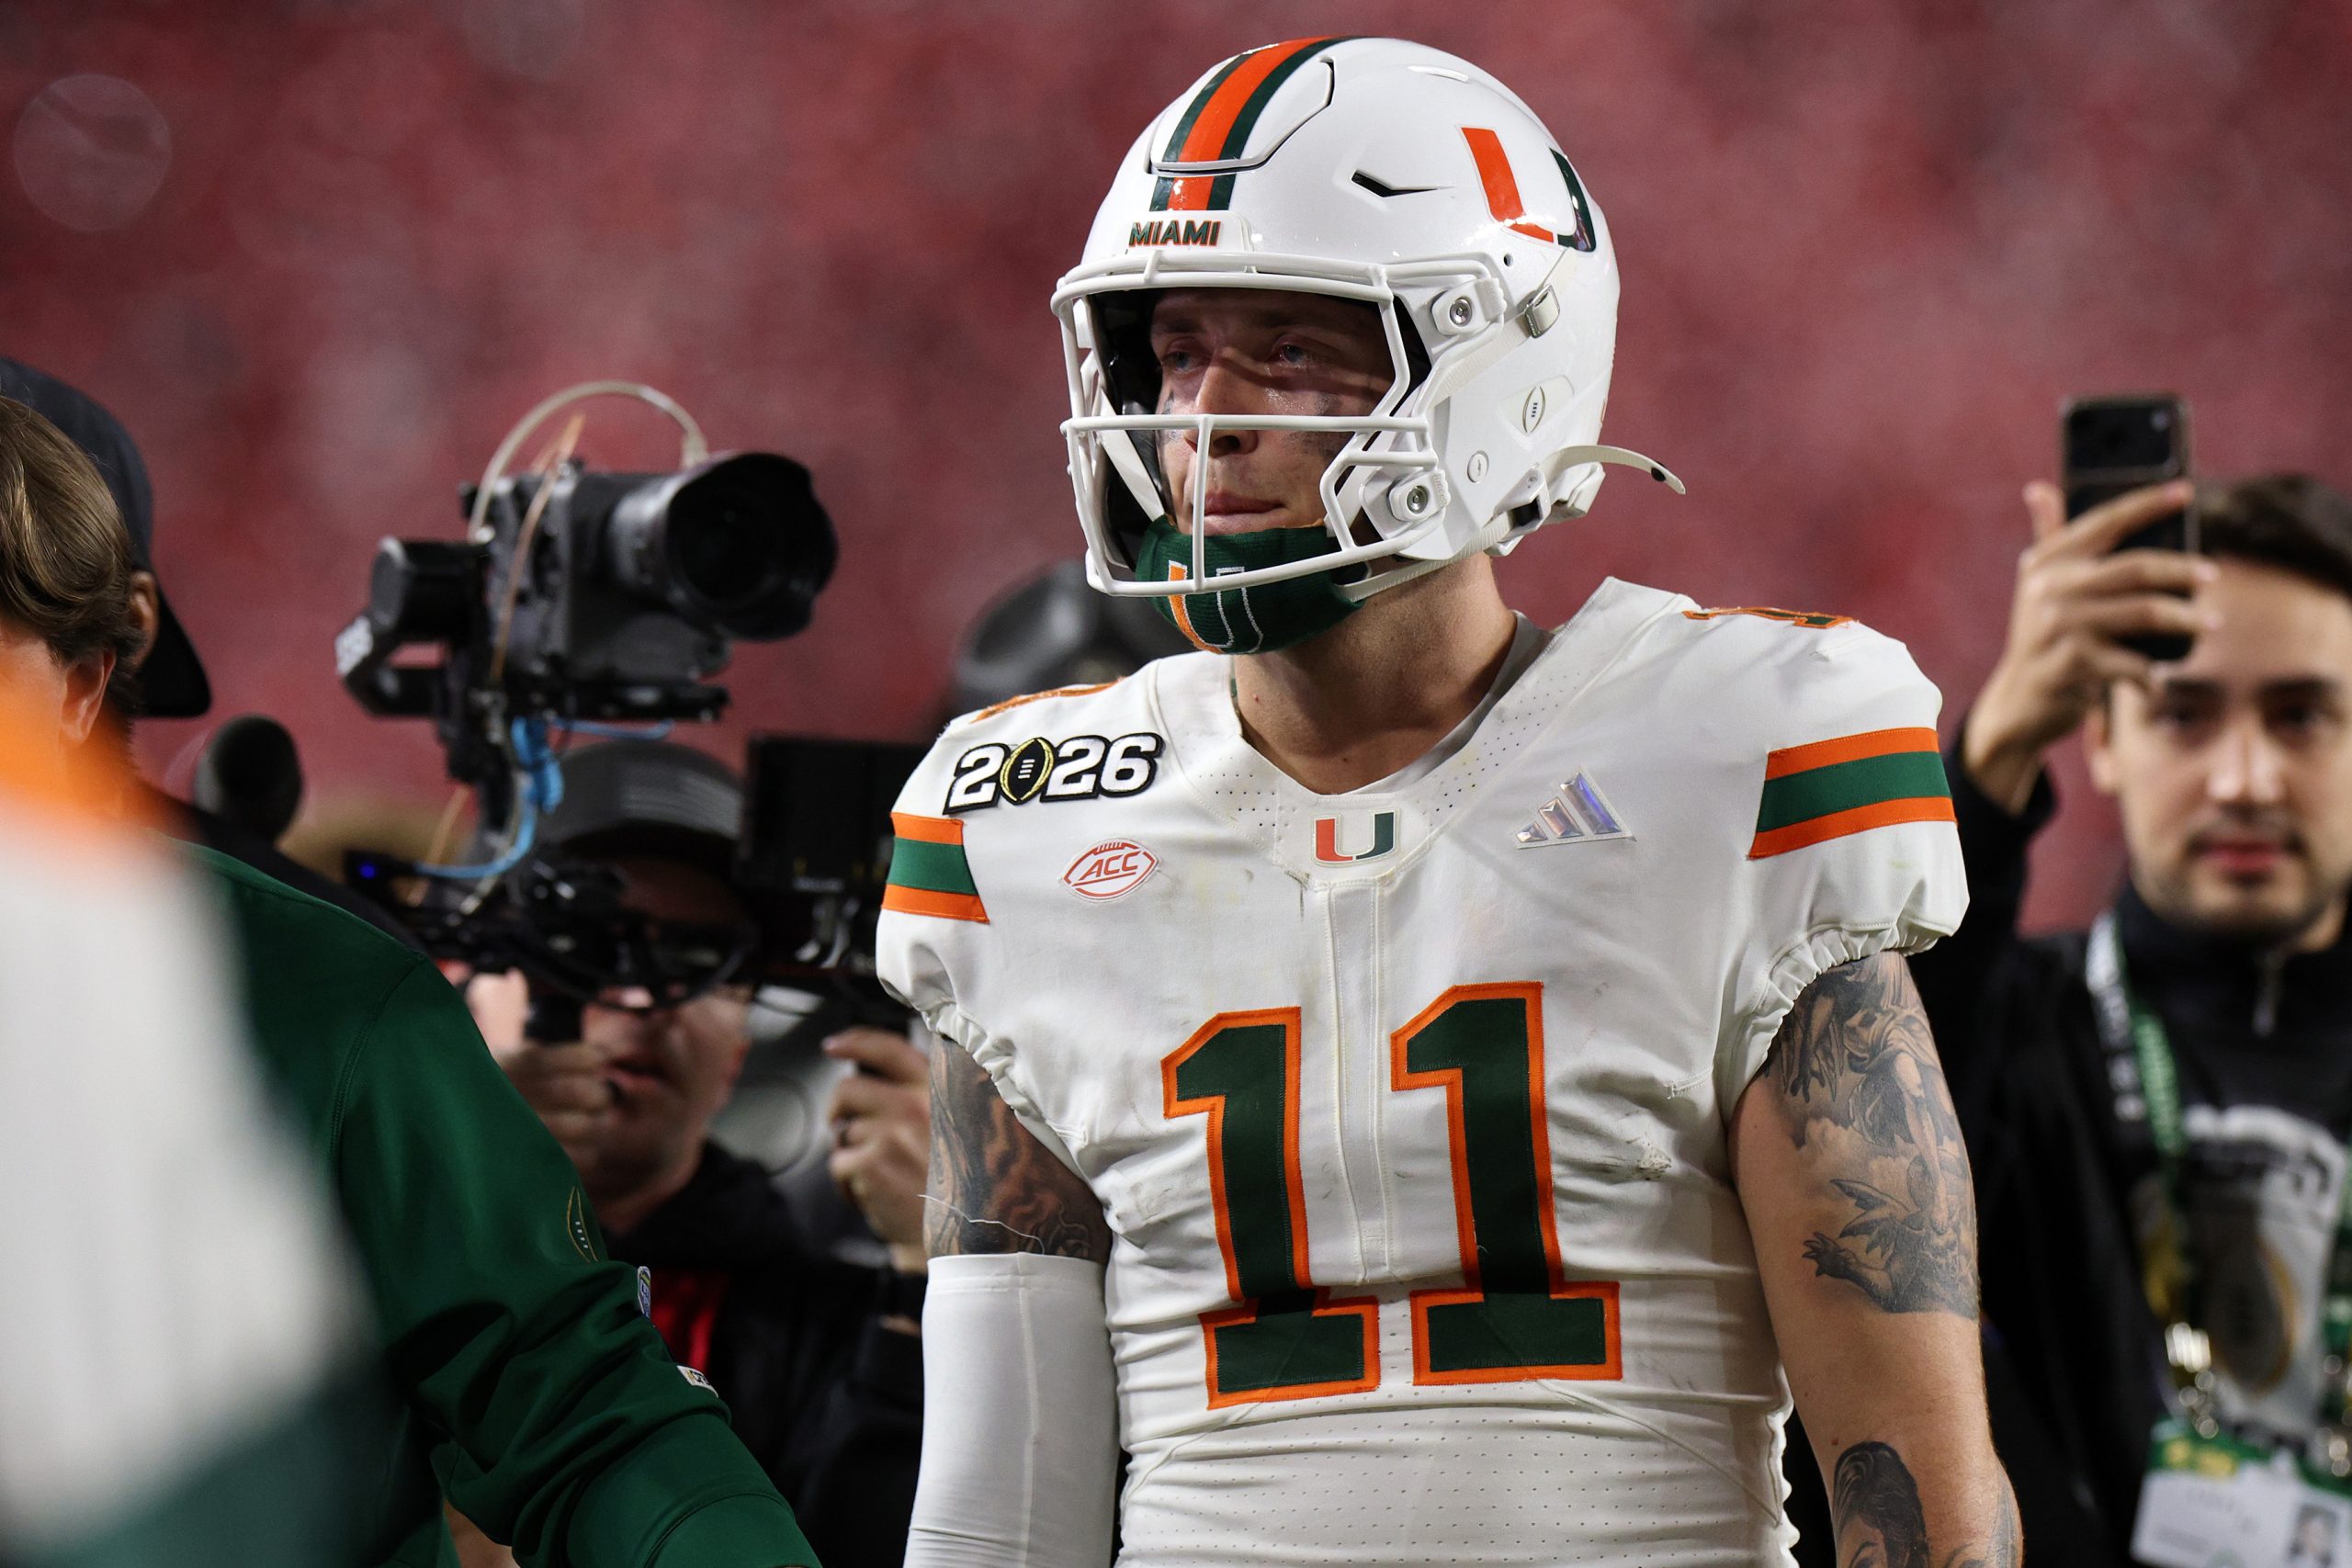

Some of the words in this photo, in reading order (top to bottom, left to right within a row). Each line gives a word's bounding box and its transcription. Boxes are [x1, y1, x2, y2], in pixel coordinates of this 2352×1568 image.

[1128, 220, 1221, 248] MIAMI
[944, 732, 1163, 816] 2026
[1315, 811, 1395, 863] U
[1079, 850, 1141, 882] ACC
[1160, 980, 1623, 1411] 11
